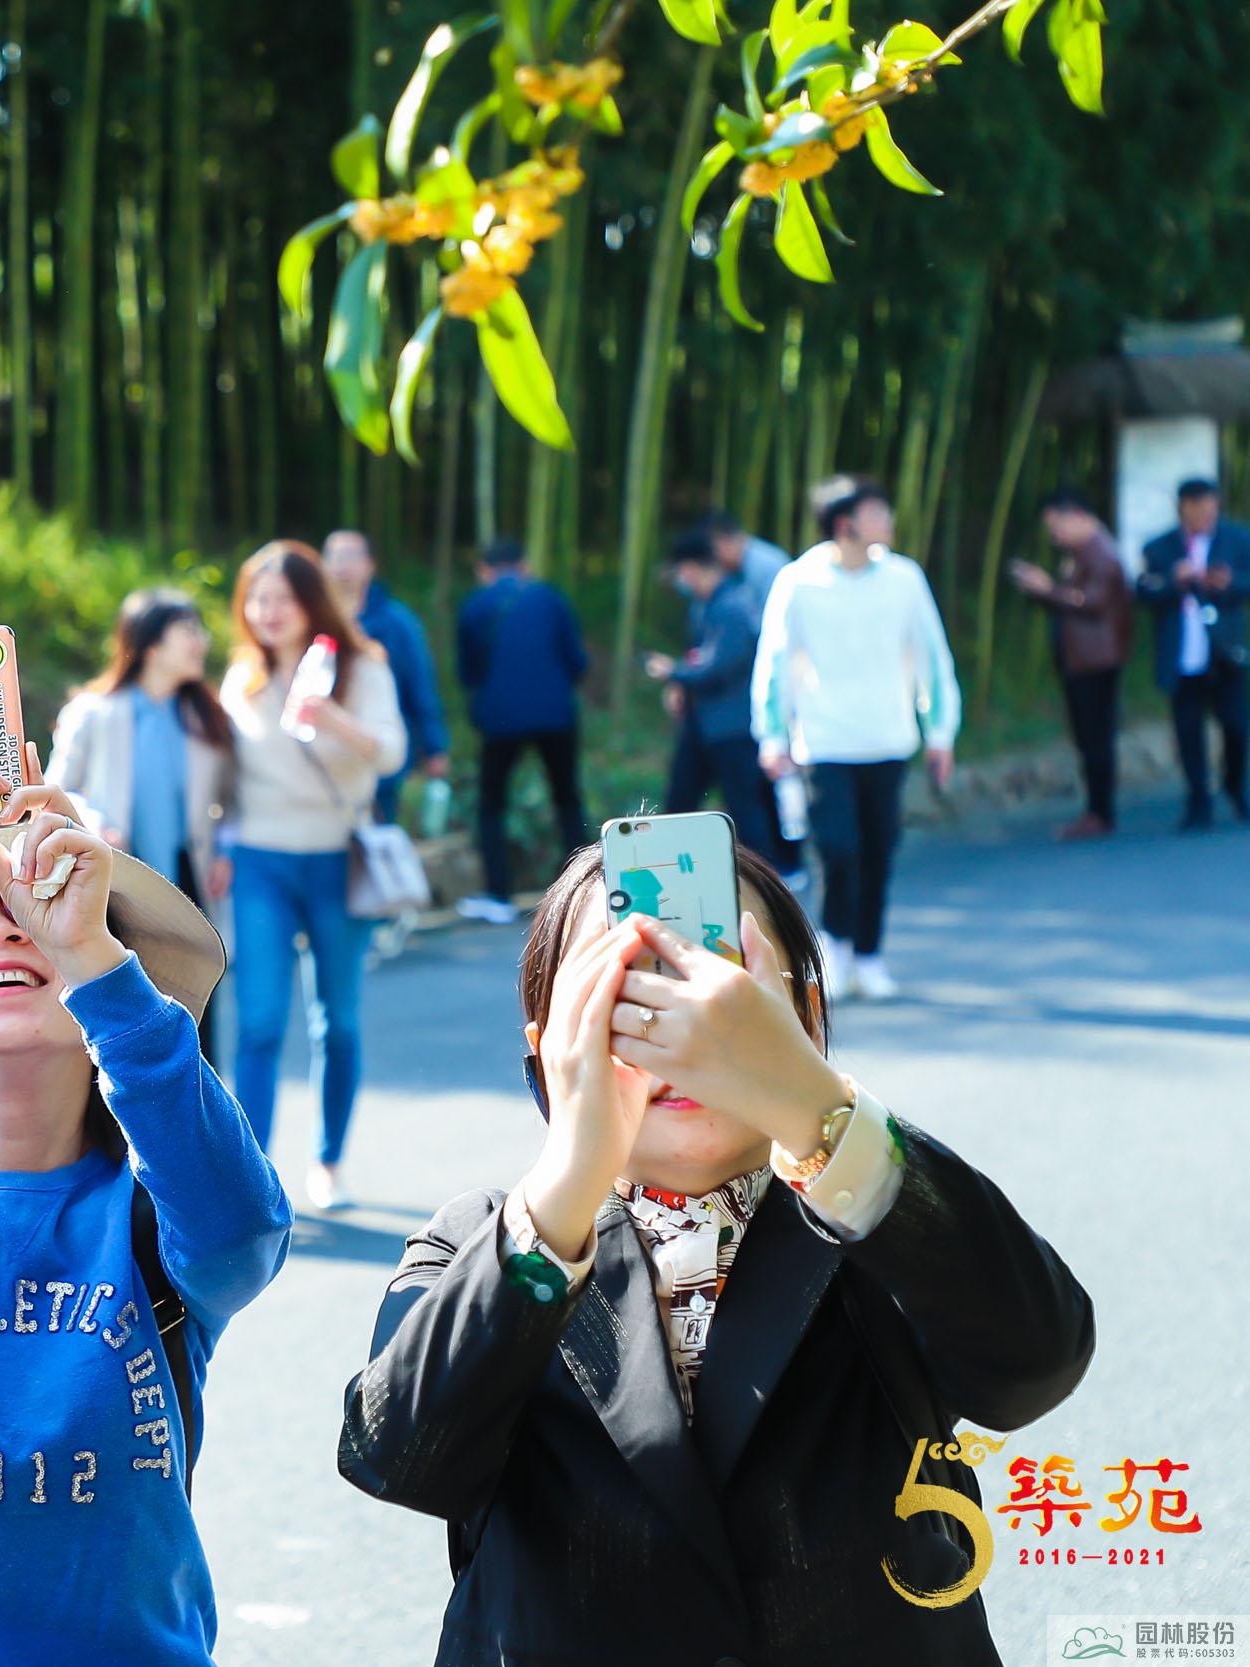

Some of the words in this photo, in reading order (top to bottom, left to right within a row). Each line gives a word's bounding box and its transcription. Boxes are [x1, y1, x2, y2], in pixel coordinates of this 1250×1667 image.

[8, 735, 18, 748] 3D
[9, 750, 20, 775] CUTE
[126, 1348, 171, 1479] DEPT
